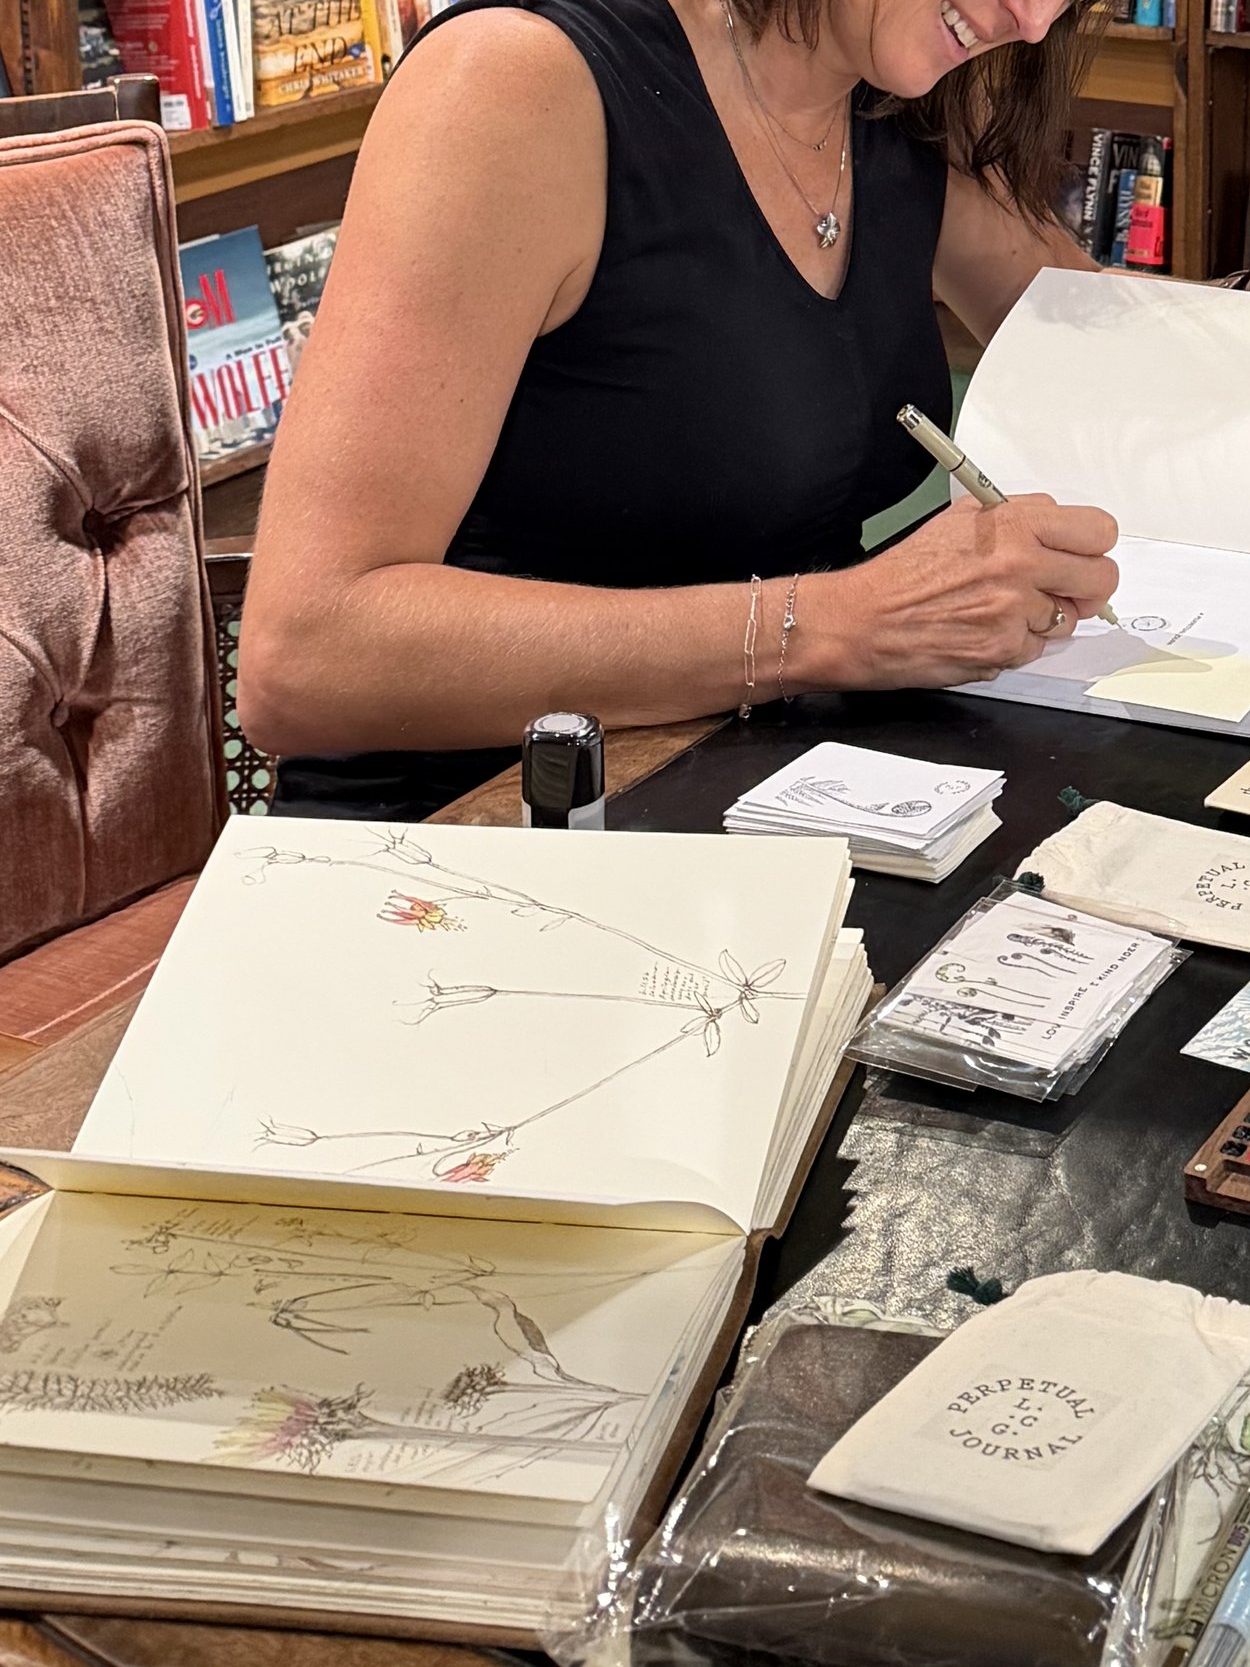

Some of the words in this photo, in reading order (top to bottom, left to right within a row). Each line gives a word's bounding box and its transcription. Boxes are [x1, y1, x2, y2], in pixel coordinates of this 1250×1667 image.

[293, 36, 348, 74] END
[190, 345, 290, 430] WOLFE
[1196, 861, 1246, 911] PERPETUAL
[1058, 985, 1089, 1021] INSPIRE
[946, 1377, 1096, 1420] PERPETUAL
[948, 1428, 1084, 1461] JOURNAL
[1191, 1547, 1239, 1622] MICRON
